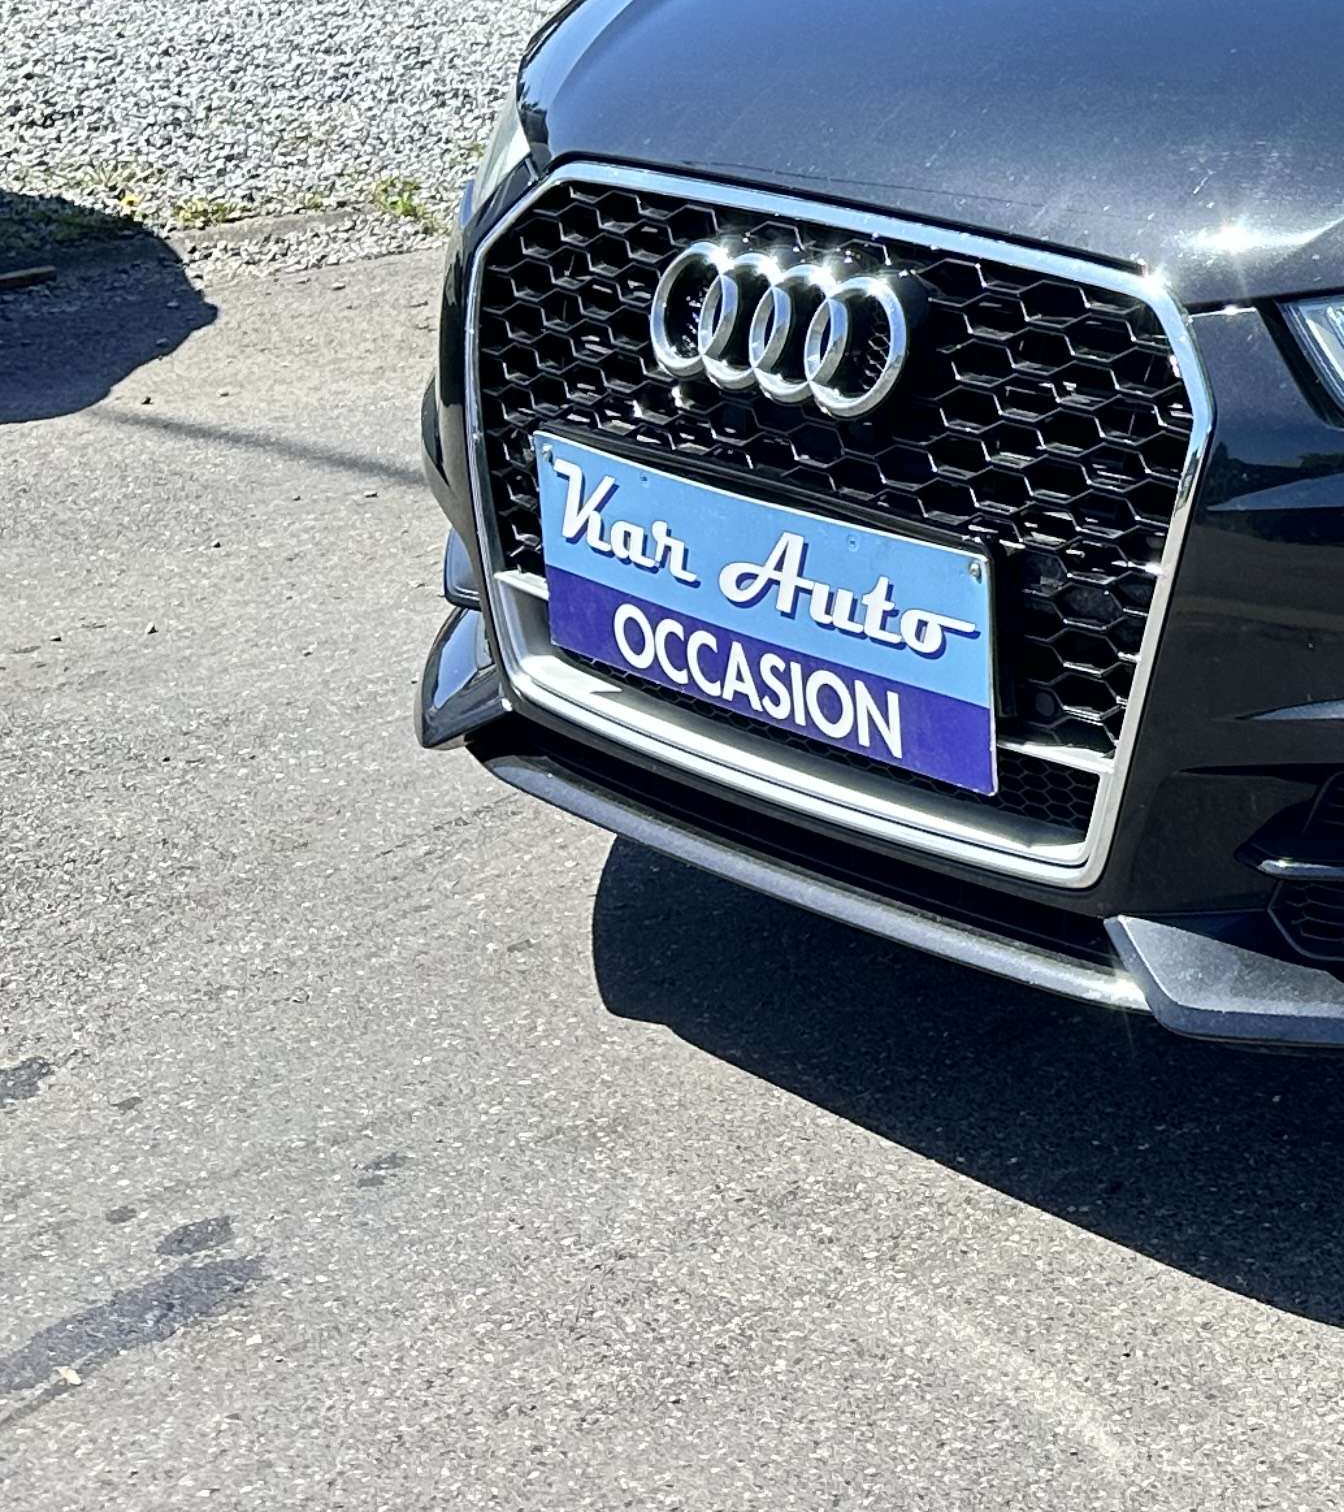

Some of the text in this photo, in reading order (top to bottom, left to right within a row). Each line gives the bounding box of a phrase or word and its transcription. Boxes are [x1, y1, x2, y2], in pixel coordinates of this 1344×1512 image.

[553, 459, 980, 658] Kar Auto
[613, 602, 903, 759] OCCASION
